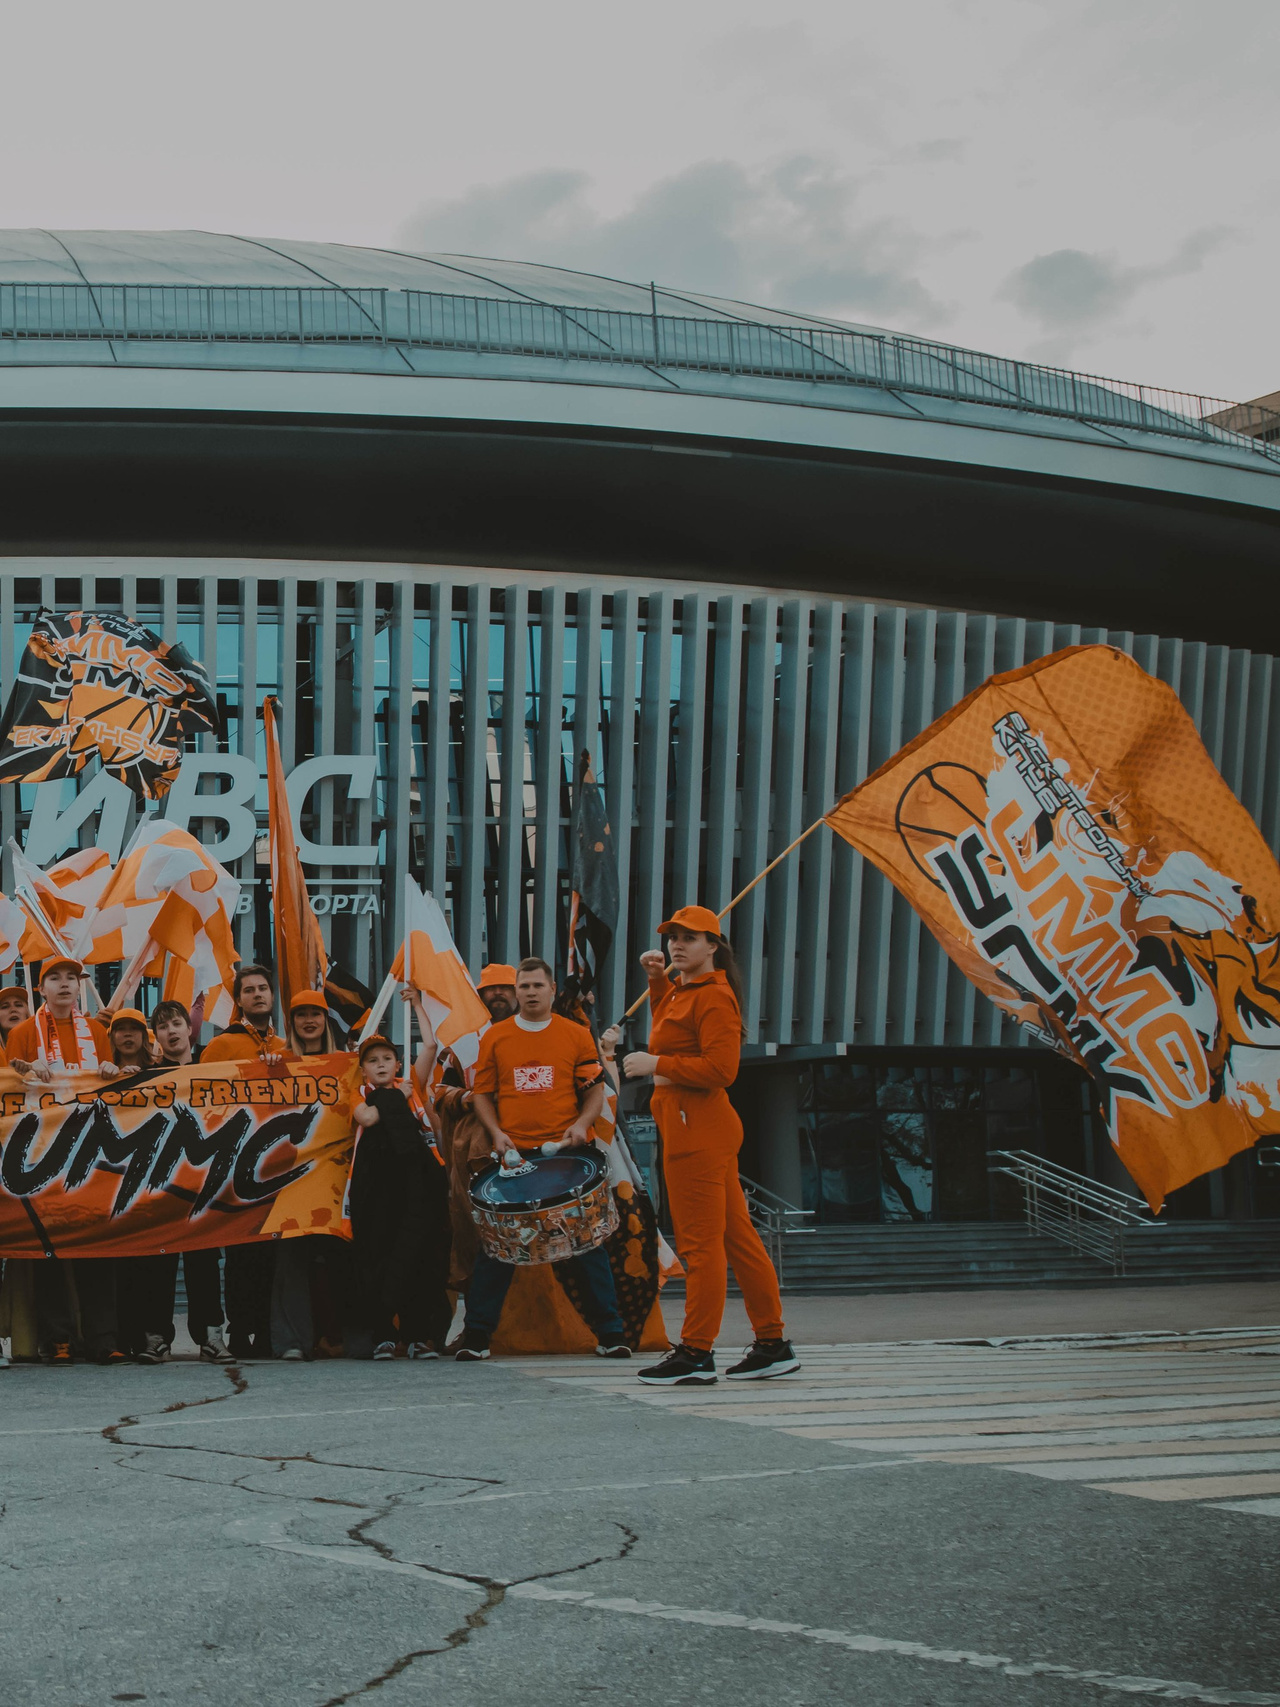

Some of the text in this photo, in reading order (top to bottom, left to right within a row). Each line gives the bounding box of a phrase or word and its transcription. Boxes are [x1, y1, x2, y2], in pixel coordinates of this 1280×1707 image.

[992, 713, 1060, 818] КЛУБ
[269, 894, 381, 915] ОРТА
[986, 798, 1210, 1109] UMMC
[189, 1076, 339, 1107] FRIENDS
[1, 1099, 320, 1221] UMMC
